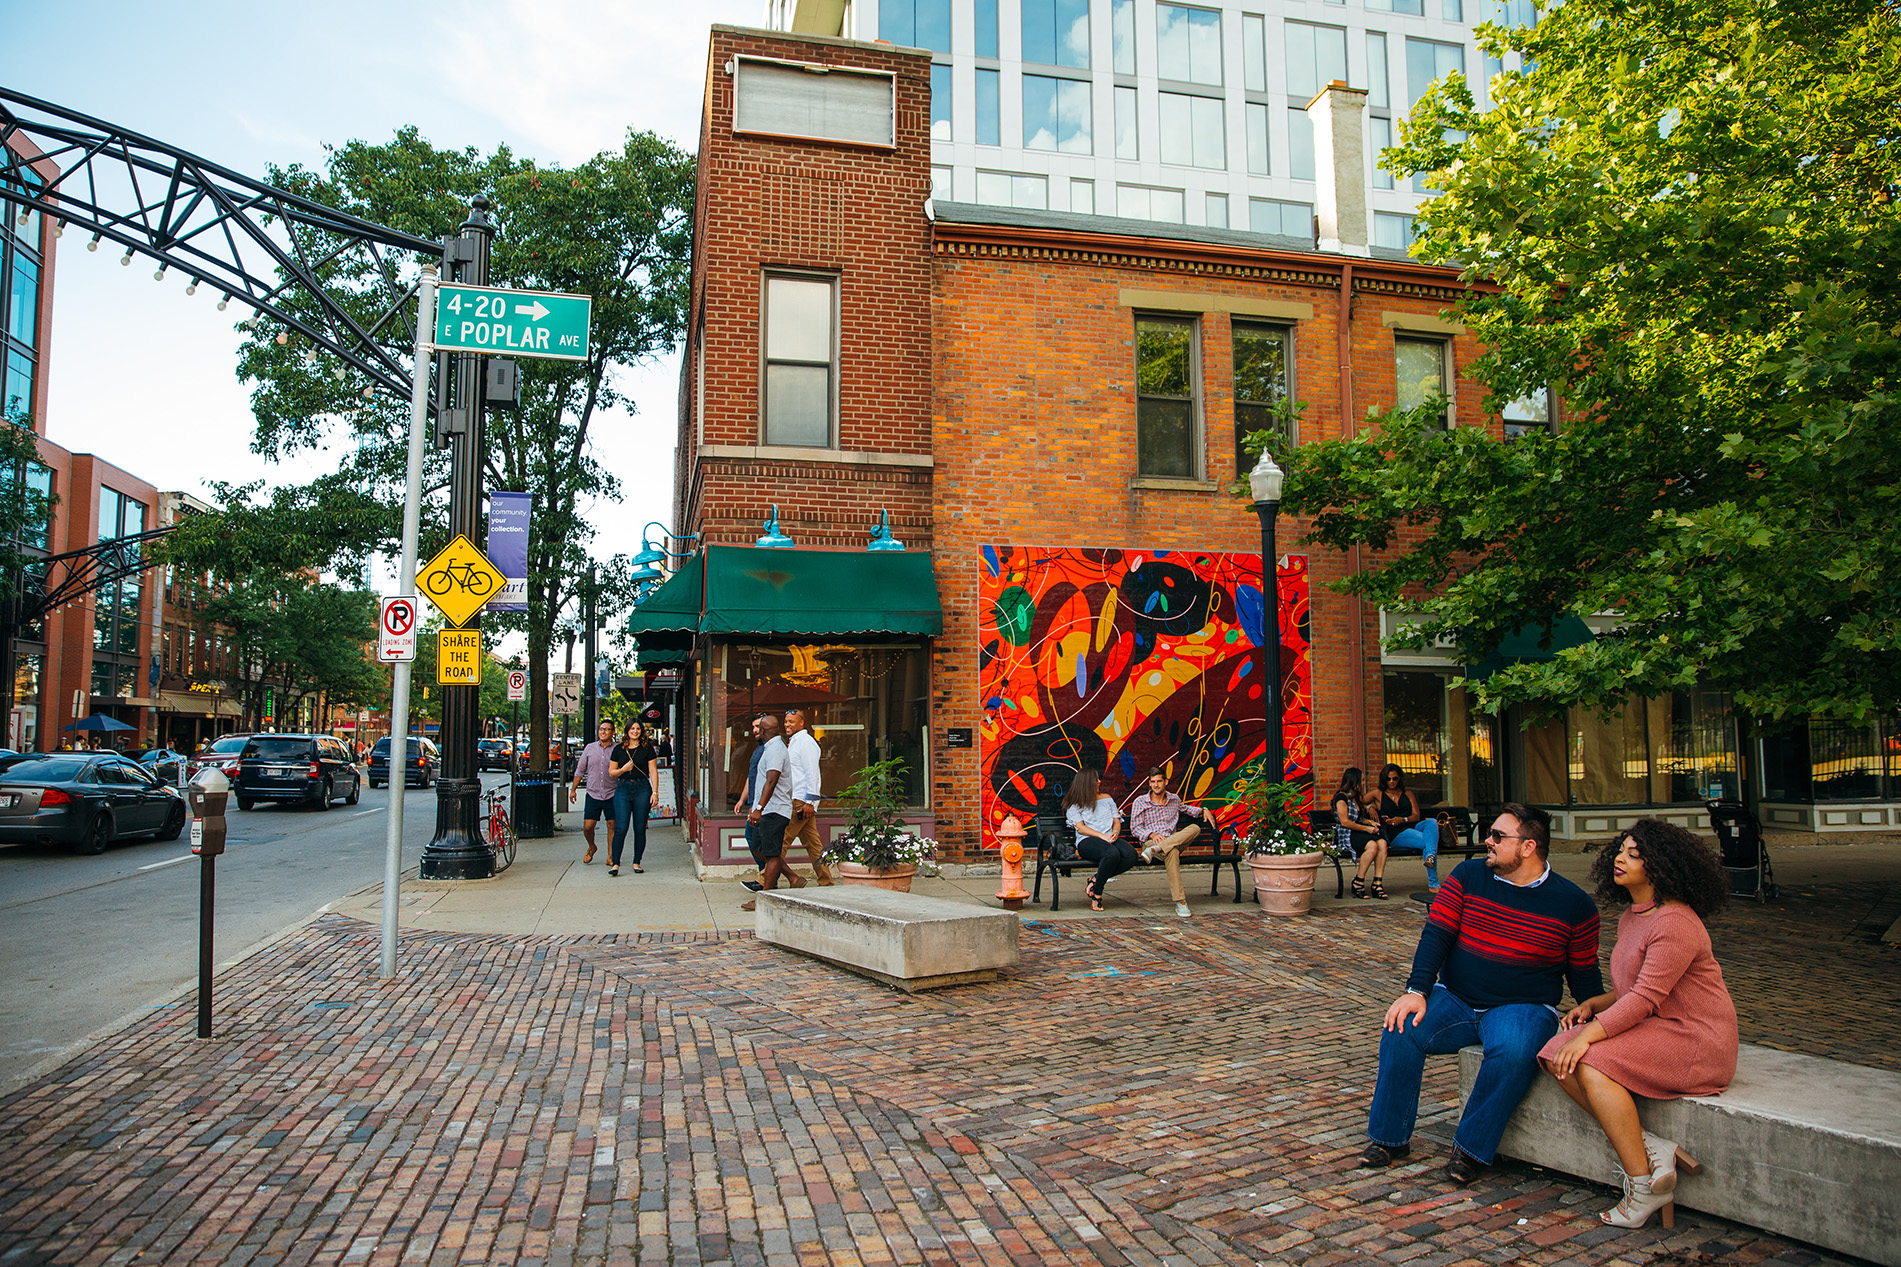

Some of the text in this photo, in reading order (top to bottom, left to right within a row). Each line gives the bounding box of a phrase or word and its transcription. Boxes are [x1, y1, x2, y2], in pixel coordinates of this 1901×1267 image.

[447, 294, 506, 319] 4-20
[444, 321, 580, 349] E POPLAR AVE
[382, 638, 413, 646] LOADING ZONE
[442, 636, 477, 647] SHARE
[450, 652, 469, 662] THE
[445, 667, 474, 677] ROAD
